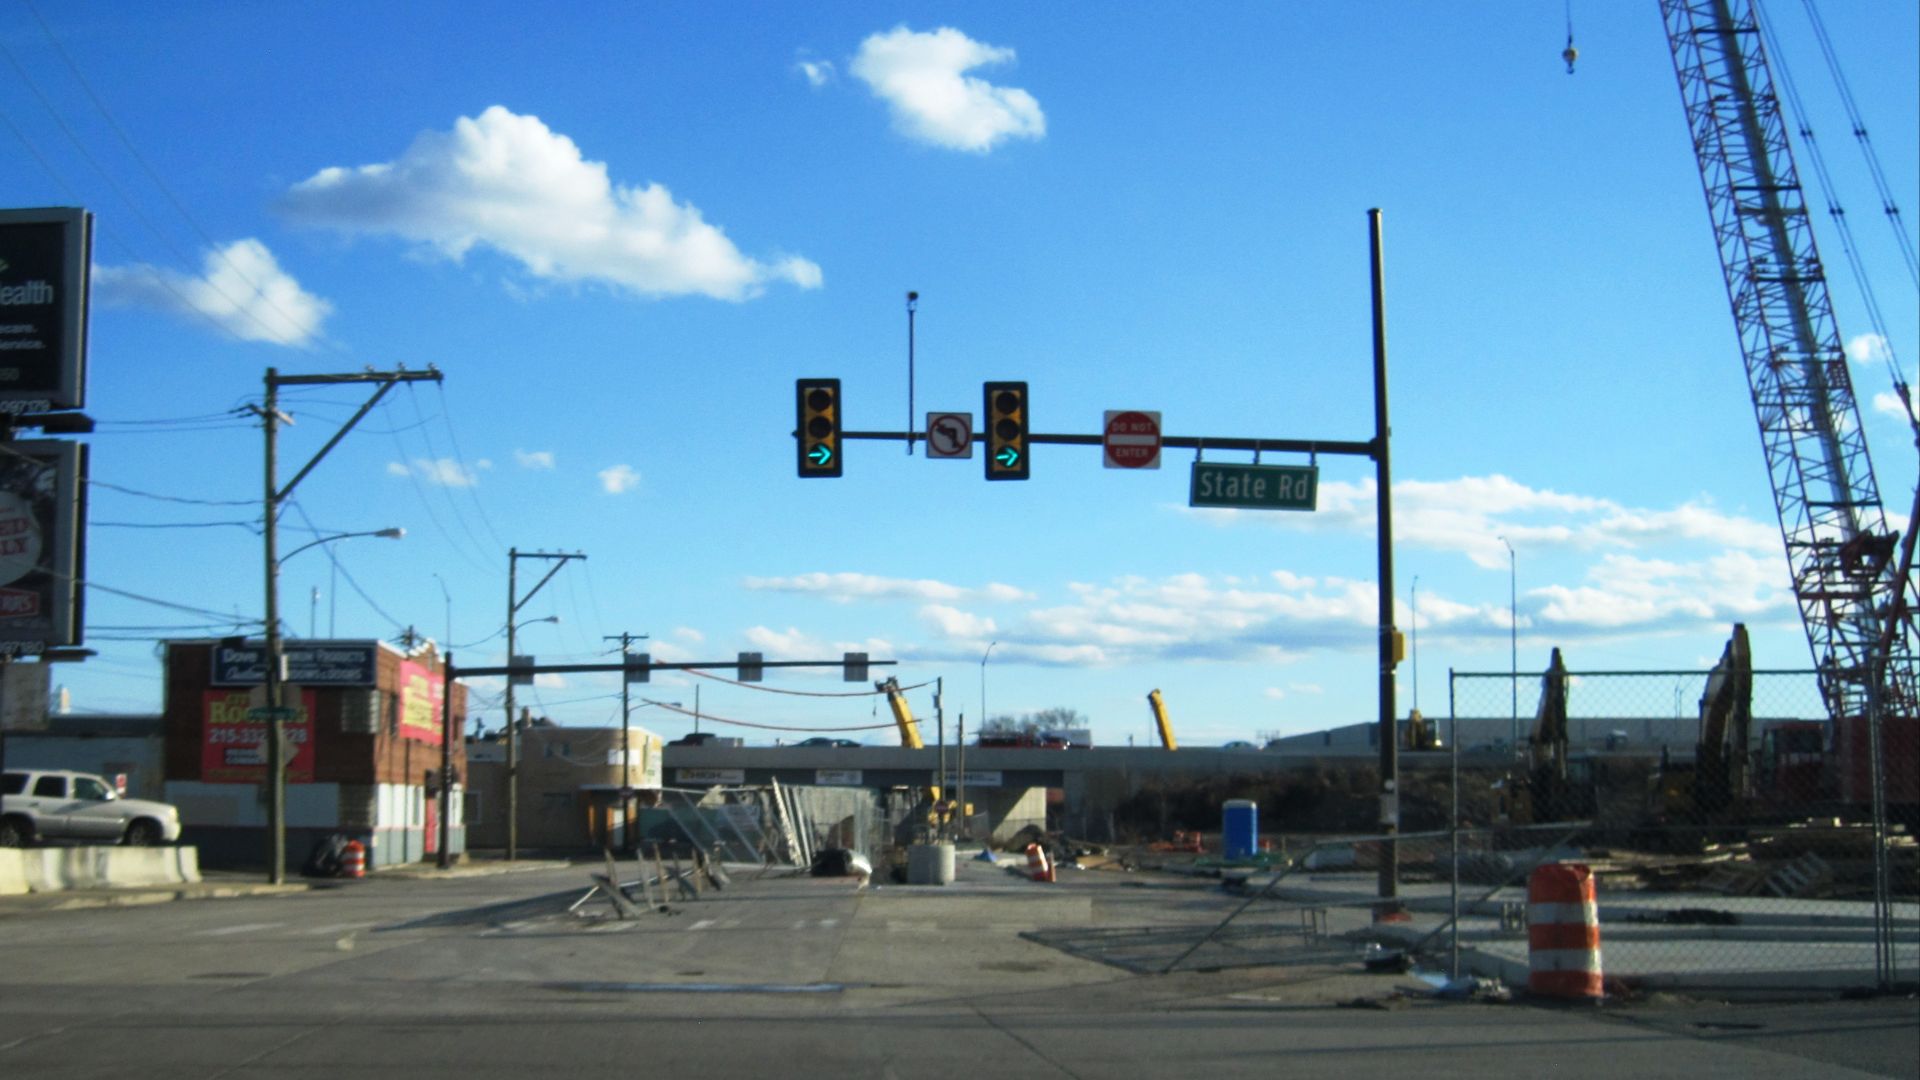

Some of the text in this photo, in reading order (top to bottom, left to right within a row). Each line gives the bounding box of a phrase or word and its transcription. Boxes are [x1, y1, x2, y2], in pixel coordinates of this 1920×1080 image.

[0, 279, 54, 305] ealth
[1112, 422, 1153, 432] DO NOT
[1116, 447, 1148, 458] ENTER
[1201, 471, 1309, 500] State Rd
